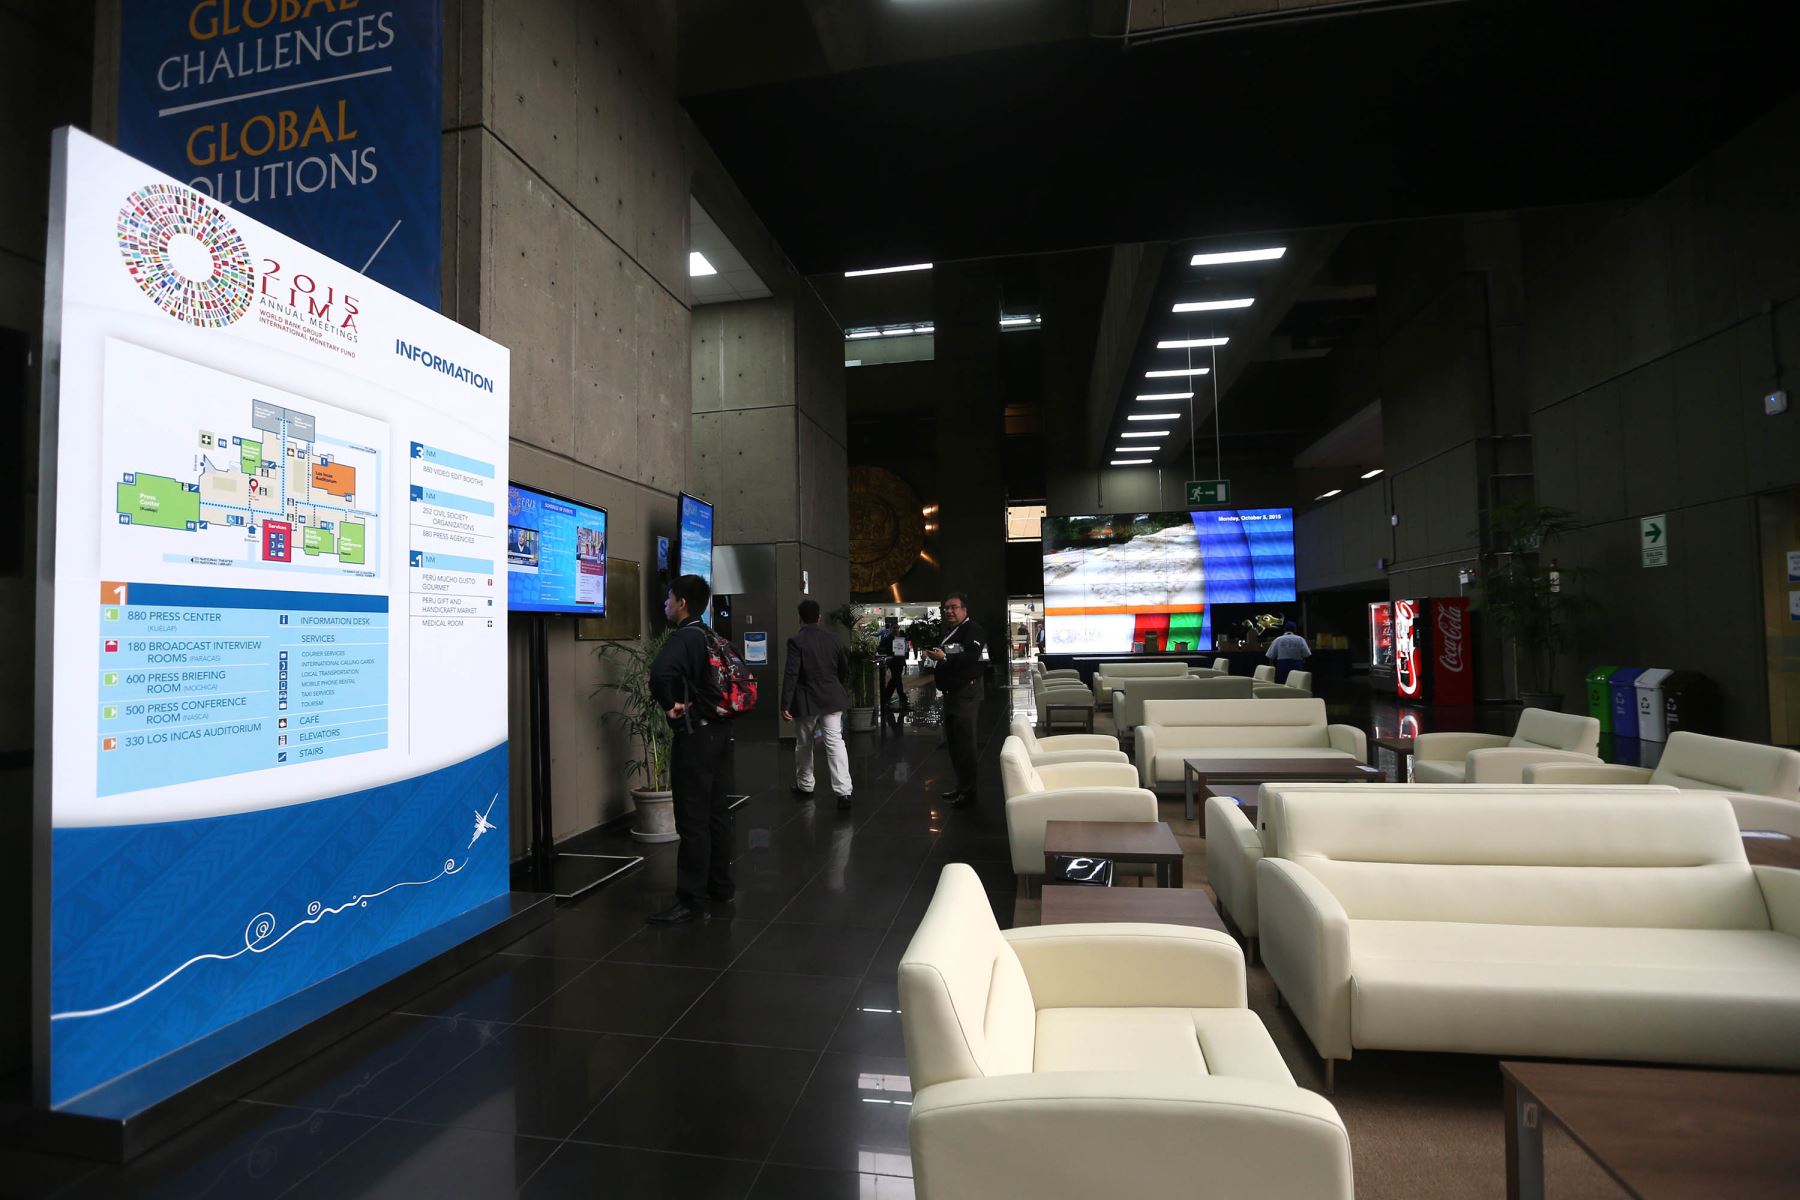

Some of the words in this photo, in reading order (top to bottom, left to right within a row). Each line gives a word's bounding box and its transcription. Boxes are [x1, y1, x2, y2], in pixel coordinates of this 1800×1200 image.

[158, 11, 395, 92] CHALLENGES
[186, 99, 358, 167] GLOBAL
[263, 258, 359, 315] 2015
[261, 275, 358, 334] LIMA
[260, 297, 304, 321] ANNUAL
[309, 317, 358, 343] MEETINGS
[260, 309, 283, 323] WORLD
[285, 319, 301, 330] BANK
[302, 326, 323, 338] GROUP
[259, 316, 307, 340] INTERNATIONAL
[309, 336, 340, 352] MONETARY
[340, 348, 356, 358] FUND
[395, 338, 494, 393] INFORMATION
[426, 450, 437, 458] NM
[434, 468, 451, 478] VIDEO
[426, 492, 436, 500] NM
[447, 512, 469, 521] SOCIETY
[432, 518, 475, 532] ORGANIZATIONS
[433, 532, 449, 540] PRESS
[450, 534, 475, 544] AGENCIES
[422, 574, 437, 582] PERU
[422, 583, 449, 591] GOURMET
[113, 585, 127, 606] 1
[422, 606, 456, 614] HANDICRAFT
[128, 611, 147, 621] 880
[150, 612, 181, 621] PRESS
[183, 612, 222, 622] CENTER
[300, 616, 352, 625] INFORMATION
[301, 634, 335, 643] SERVICES
[128, 642, 146, 652] 180
[150, 641, 211, 651] BROADCAST
[214, 641, 262, 650] INTERVIEW
[148, 654, 188, 663] ROOMS
[126, 674, 146, 684] 600
[148, 673, 179, 683] PRESS
[182, 671, 226, 681] BRIEFING
[319, 669, 360, 677] TRANSPORTATION
[147, 683, 181, 694] ROOM
[126, 705, 145, 716] 500
[148, 703, 179, 713] PRESS
[182, 697, 247, 711] CONFERENCE
[146, 713, 180, 724] ROOM
[300, 714, 320, 725] CAFÉ
[126, 736, 144, 747] 330
[148, 734, 168, 744] LOS
[170, 730, 201, 741] INCAS
[204, 722, 262, 738] AUDITORIUM
[300, 729, 340, 742] ELEVATORS
[300, 747, 324, 758] STAIRS
